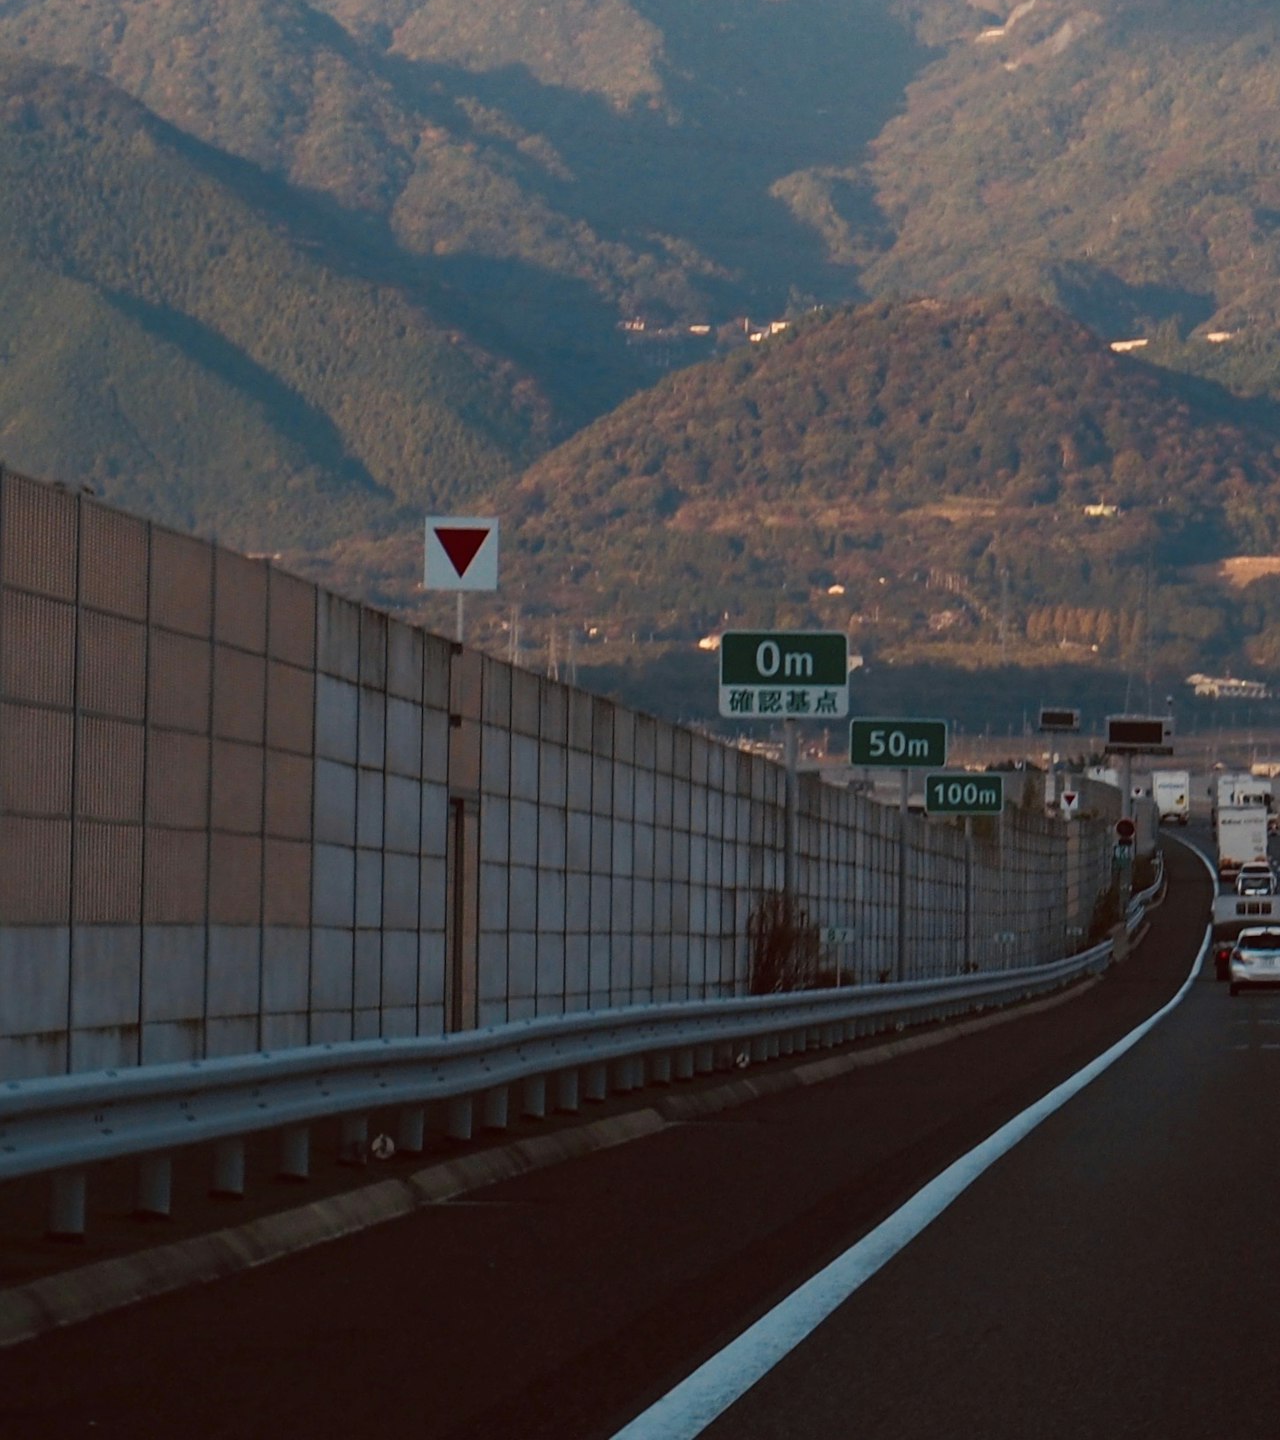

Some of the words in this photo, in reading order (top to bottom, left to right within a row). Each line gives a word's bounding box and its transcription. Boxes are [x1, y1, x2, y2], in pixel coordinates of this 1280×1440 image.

[756, 640, 814, 677] 0m
[729, 689, 838, 714] 確認基点
[869, 730, 930, 758] 50m
[934, 782, 997, 806] 100m
